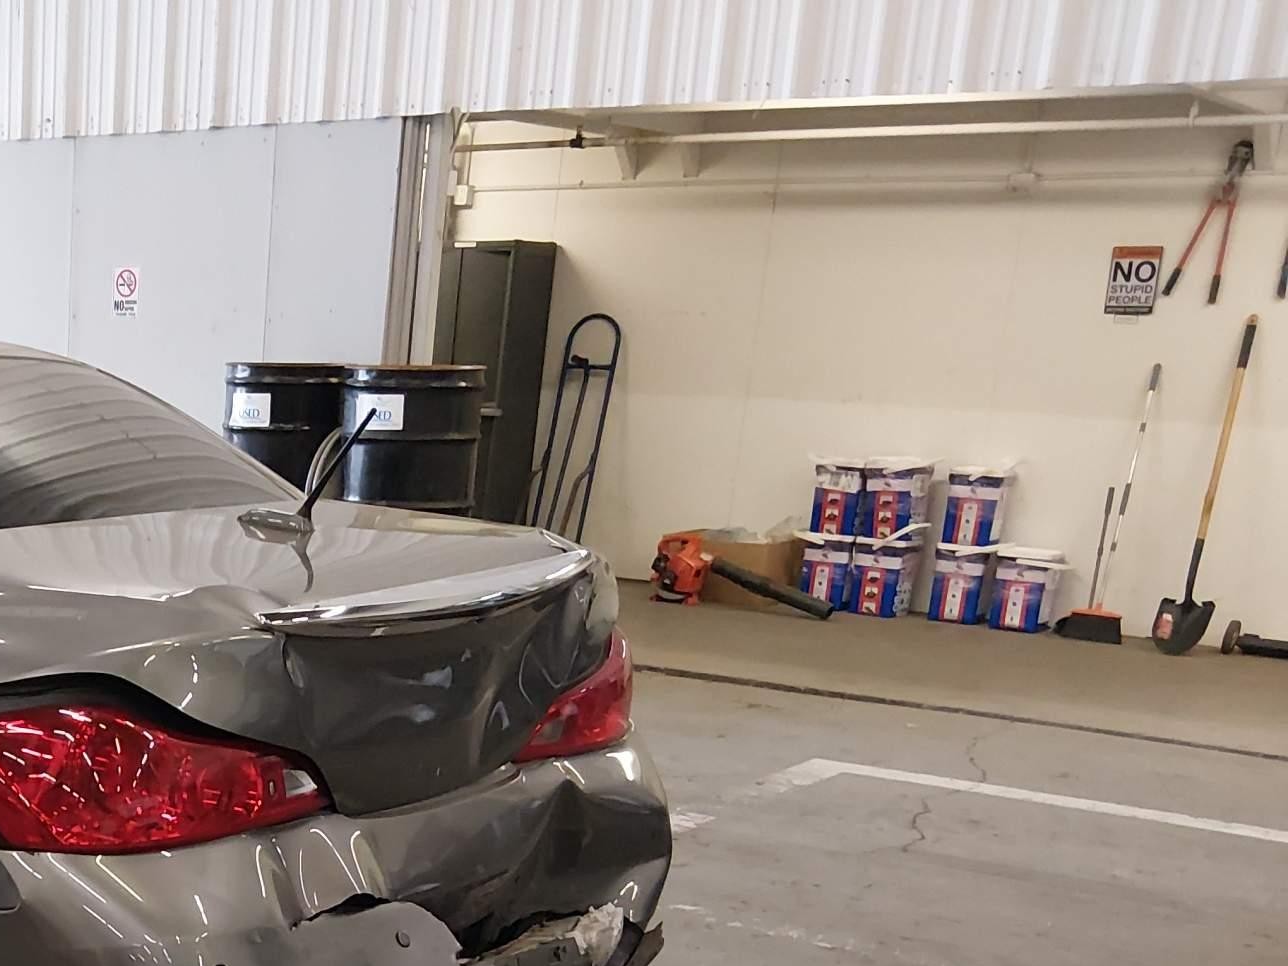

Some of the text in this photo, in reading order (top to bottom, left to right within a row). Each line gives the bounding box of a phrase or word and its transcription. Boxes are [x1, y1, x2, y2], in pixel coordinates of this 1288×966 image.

[1112, 261, 1156, 283] NO
[1110, 285, 1153, 294] STUPID
[1108, 295, 1152, 304] PEOPLE
[114, 300, 124, 311] NO
